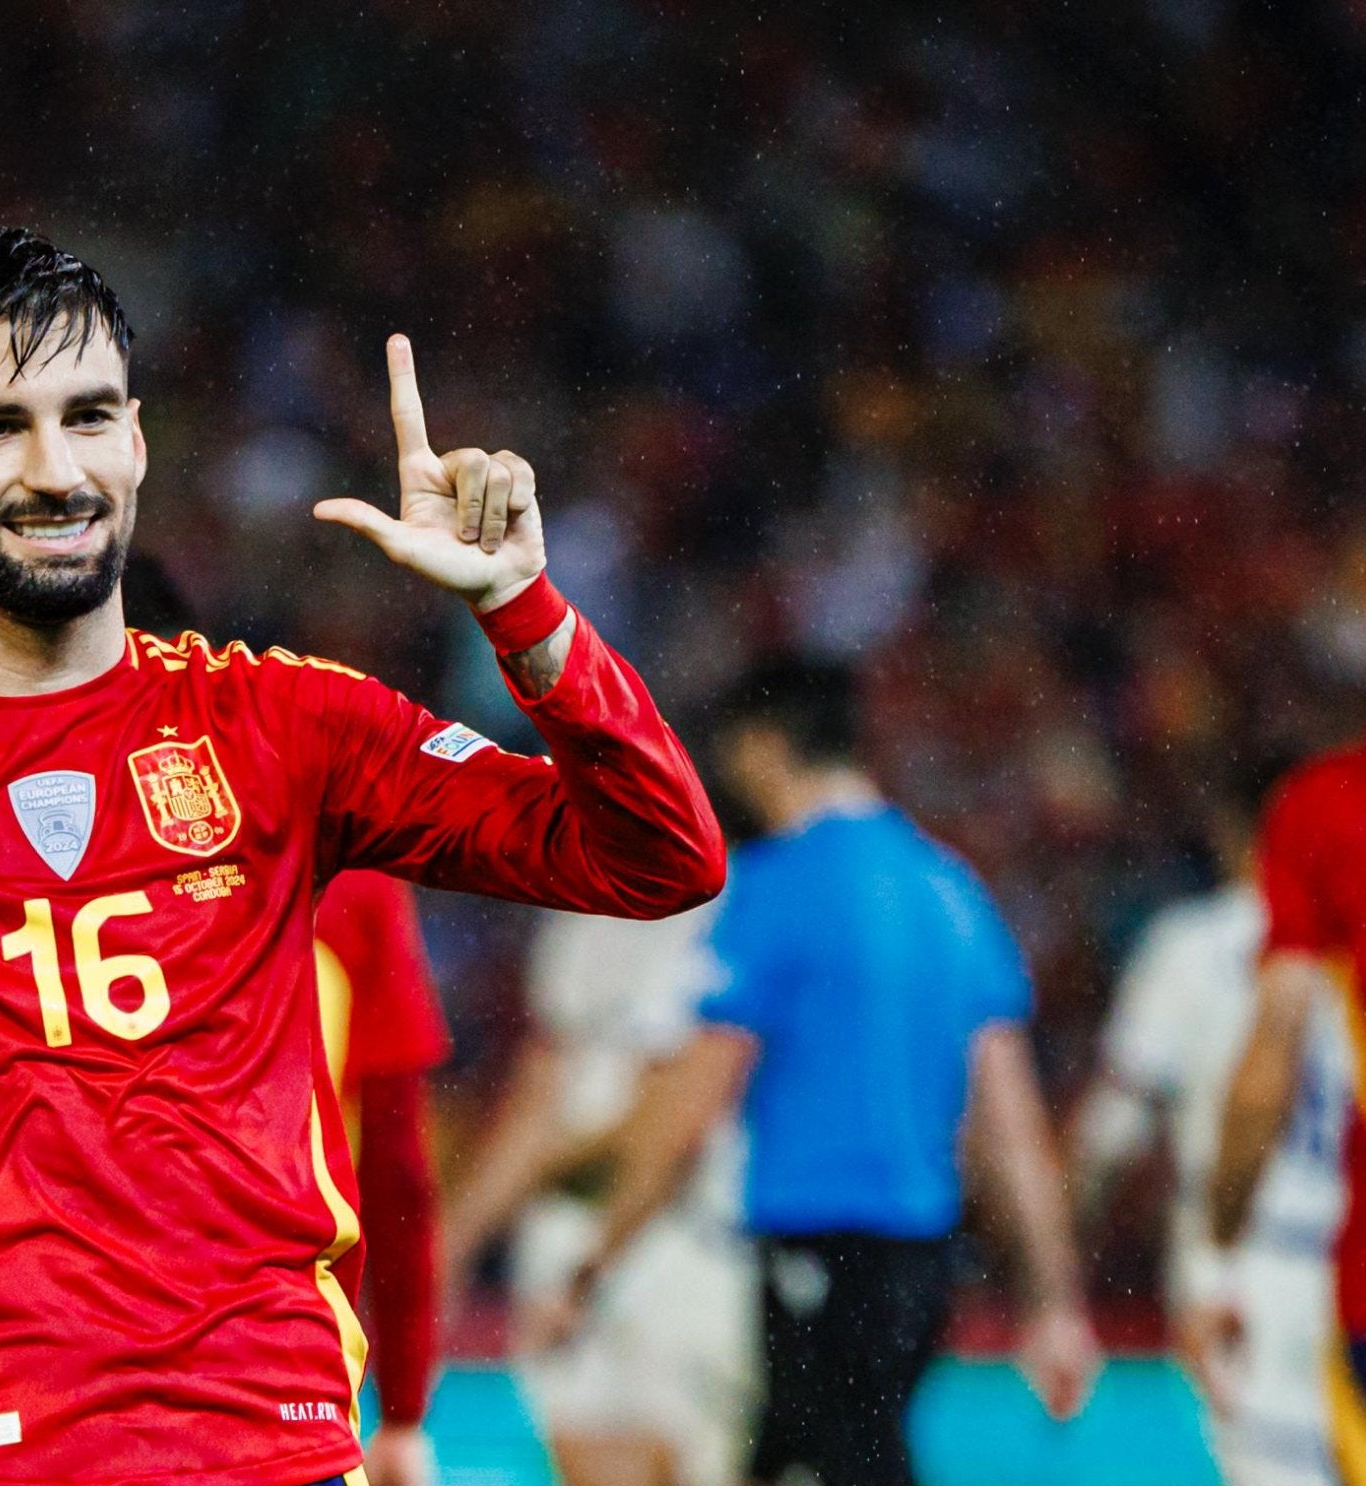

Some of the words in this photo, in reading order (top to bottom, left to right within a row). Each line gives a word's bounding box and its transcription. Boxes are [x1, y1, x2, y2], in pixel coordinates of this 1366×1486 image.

[37, 778, 63, 786] UEFA
[19, 784, 86, 800] EUROPEAN
[21, 794, 88, 809] CHAMPIONS
[45, 840, 79, 852] 2024
[177, 870, 202, 884] SPAIN
[208, 865, 239, 878] SERBIA
[184, 877, 224, 894] OCTOBER
[225, 874, 246, 887] 2024
[1, 890, 171, 1048] 16
